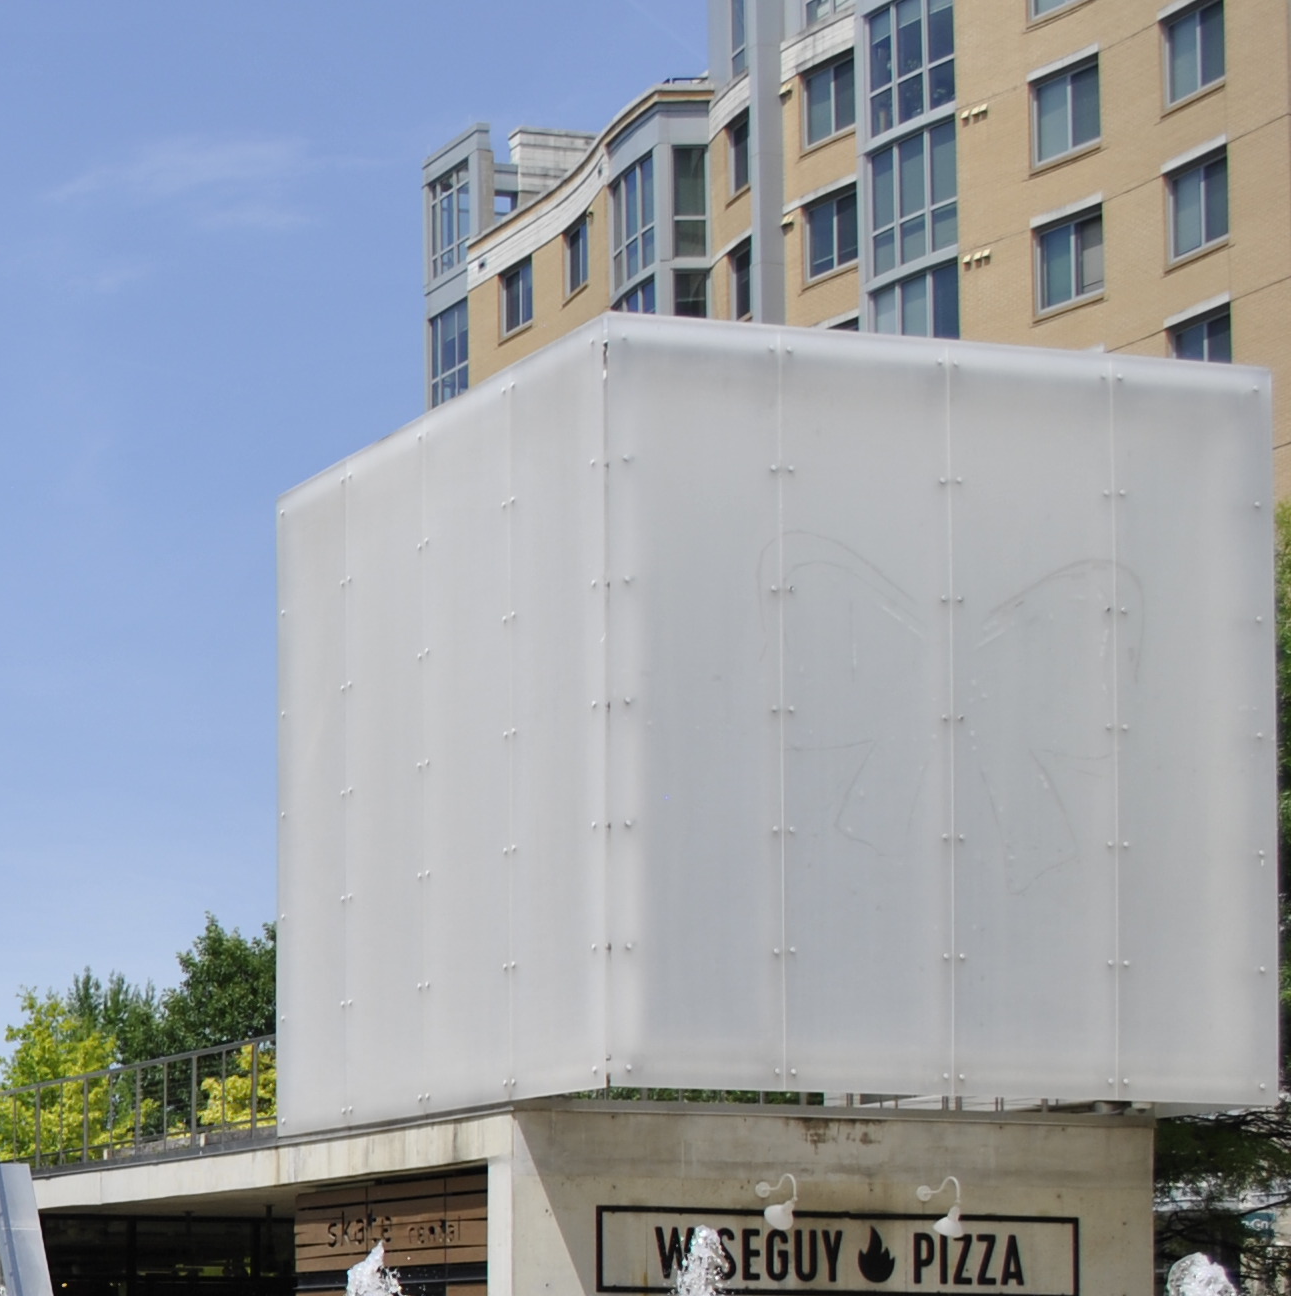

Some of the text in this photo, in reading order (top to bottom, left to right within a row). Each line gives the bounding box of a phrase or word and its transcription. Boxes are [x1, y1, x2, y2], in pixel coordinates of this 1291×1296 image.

[327, 1210, 461, 1247] skate rental
[654, 1226, 1025, 1286] WSEGUY PIZZA
